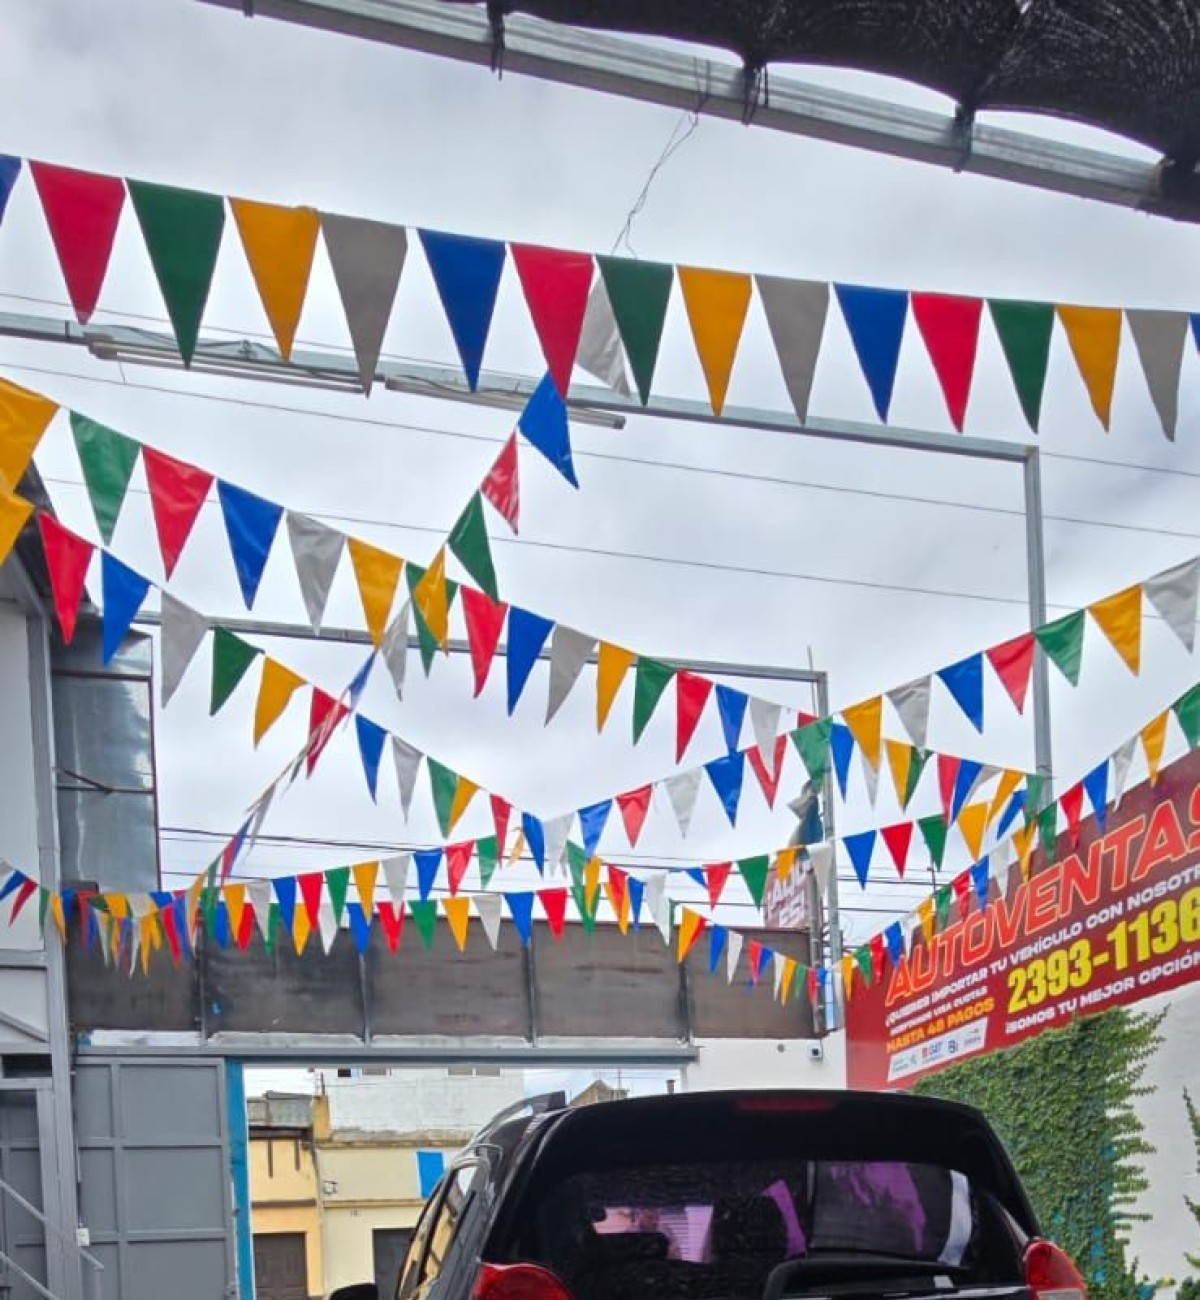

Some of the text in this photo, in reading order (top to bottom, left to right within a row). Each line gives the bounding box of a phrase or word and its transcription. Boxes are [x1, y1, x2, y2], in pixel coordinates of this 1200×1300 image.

[931, 967, 988, 1003] IMPORTAR
[989, 956, 1008, 975] TU
[1009, 921, 1083, 966] VEHÍCULO
[1085, 901, 1123, 930] CON
[1007, 886, 1200, 1015] 2393-1136
[886, 1026, 925, 1053] HASTA
[947, 996, 995, 1028] PAGOS
[1057, 998, 1078, 1015] TU
[1080, 977, 1135, 1008] MEJOR
